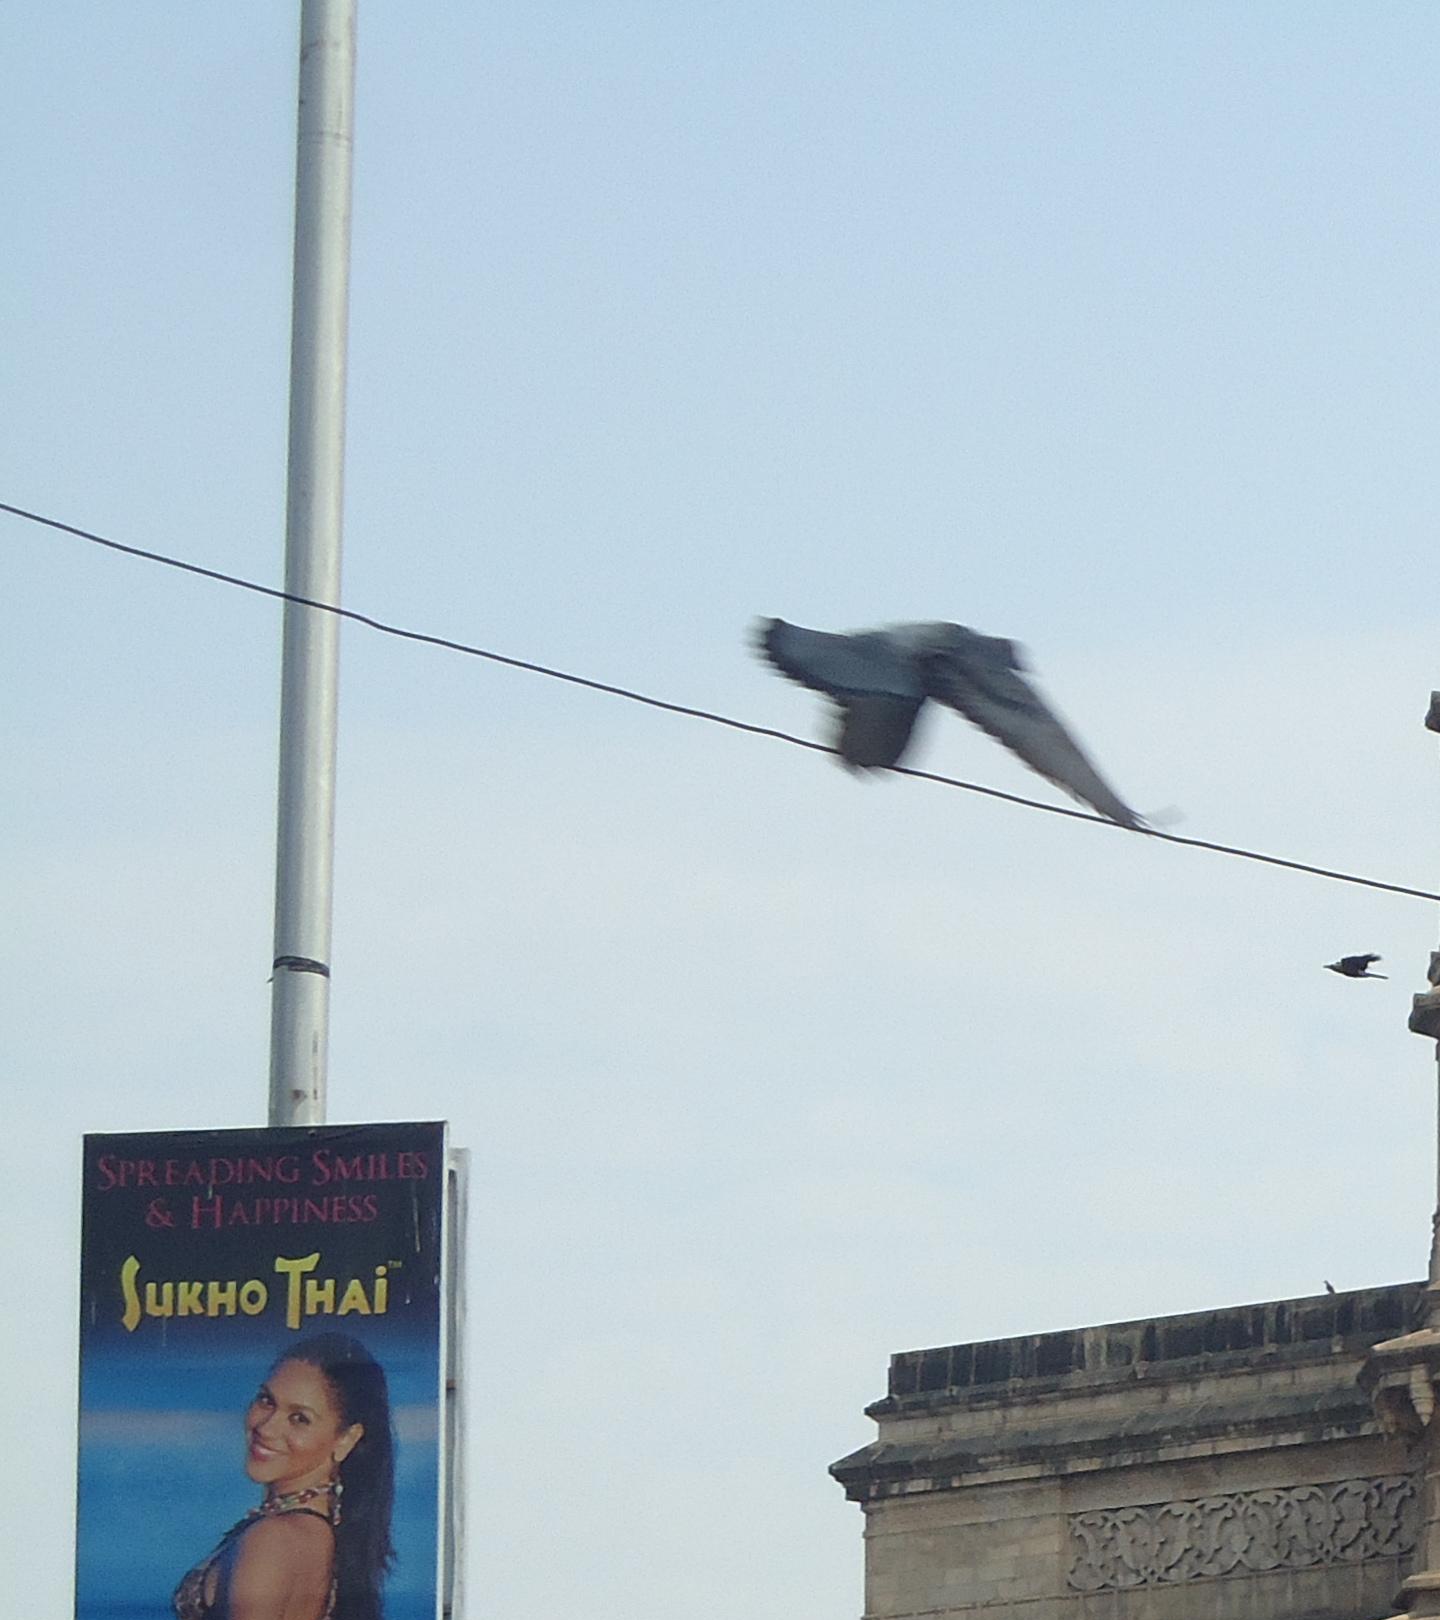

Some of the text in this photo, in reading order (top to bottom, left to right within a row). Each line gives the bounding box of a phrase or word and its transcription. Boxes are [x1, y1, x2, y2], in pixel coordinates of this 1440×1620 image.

[98, 1149, 429, 1191] SPREADING SMILES
[144, 1194, 380, 1230] & HAPPINESS
